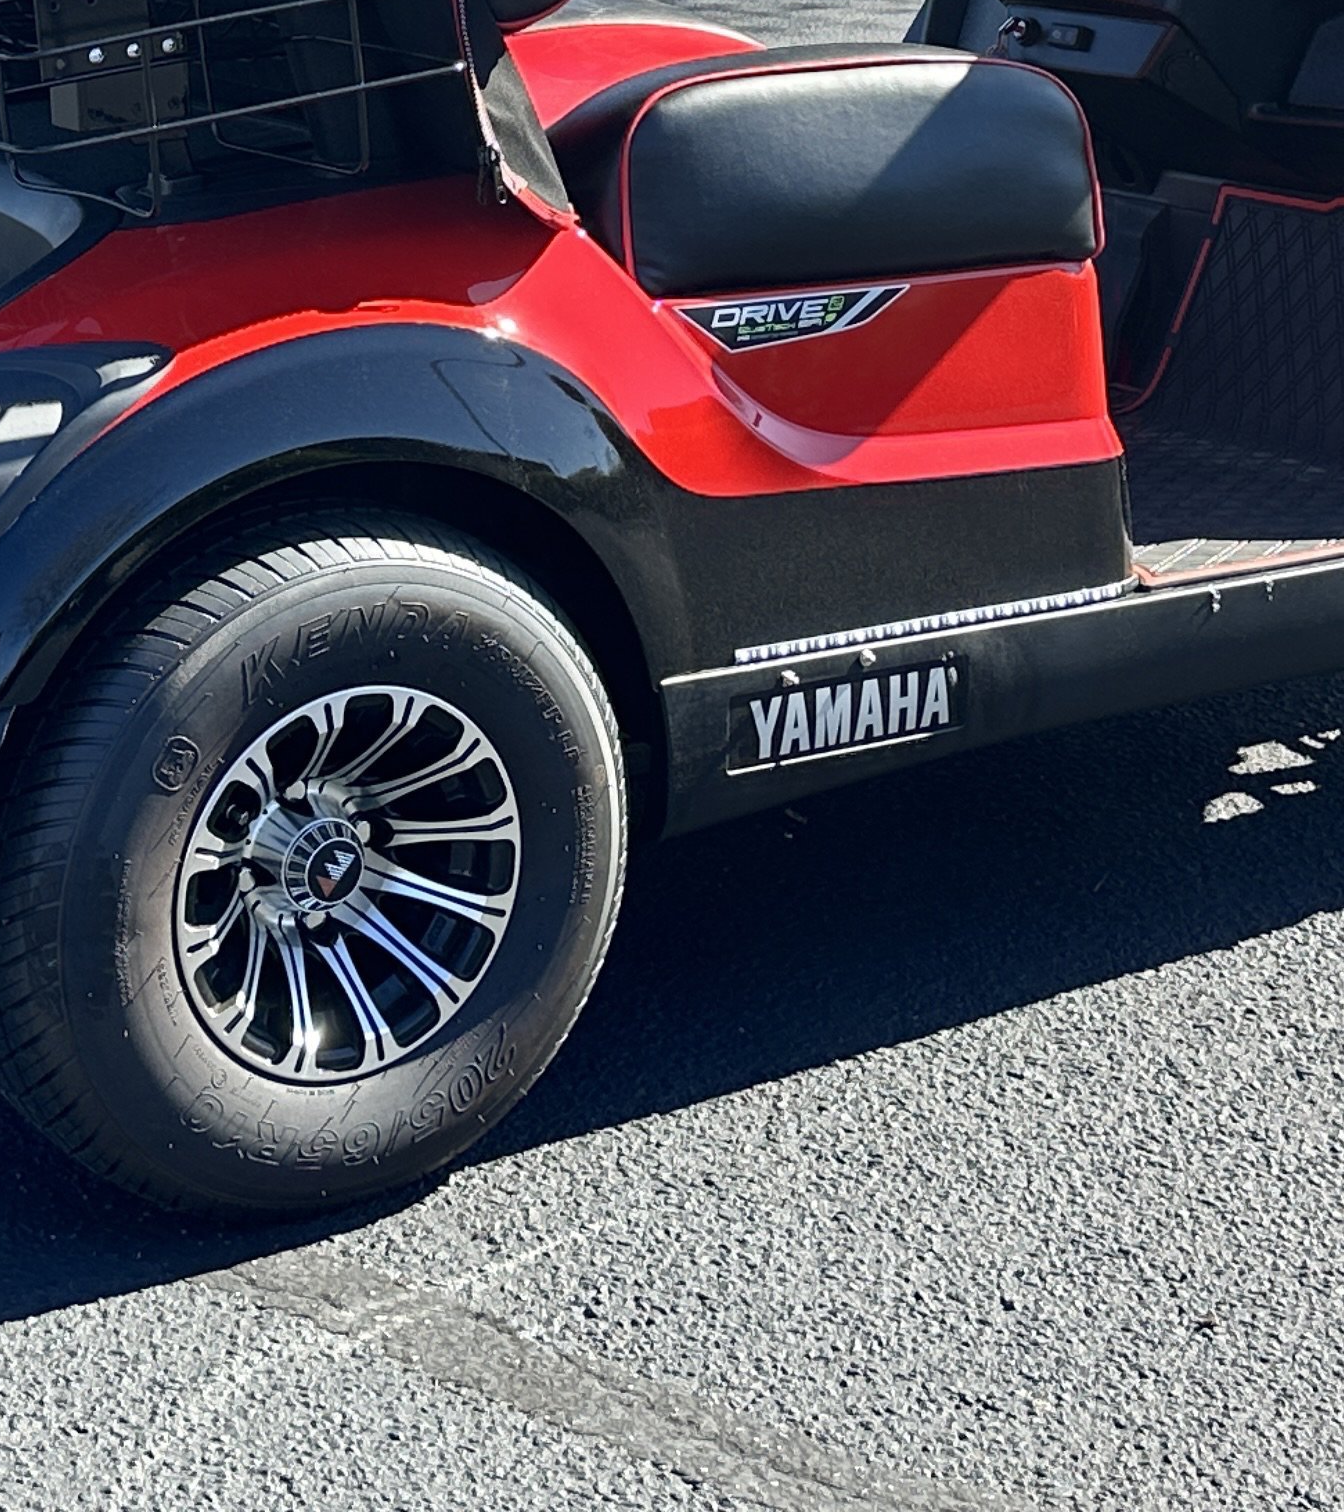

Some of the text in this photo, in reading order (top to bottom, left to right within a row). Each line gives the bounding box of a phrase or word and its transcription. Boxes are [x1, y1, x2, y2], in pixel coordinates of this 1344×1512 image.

[711, 298, 829, 329] DRIVE
[241, 599, 470, 710] KENDA
[749, 665, 950, 760] YAMAHA
